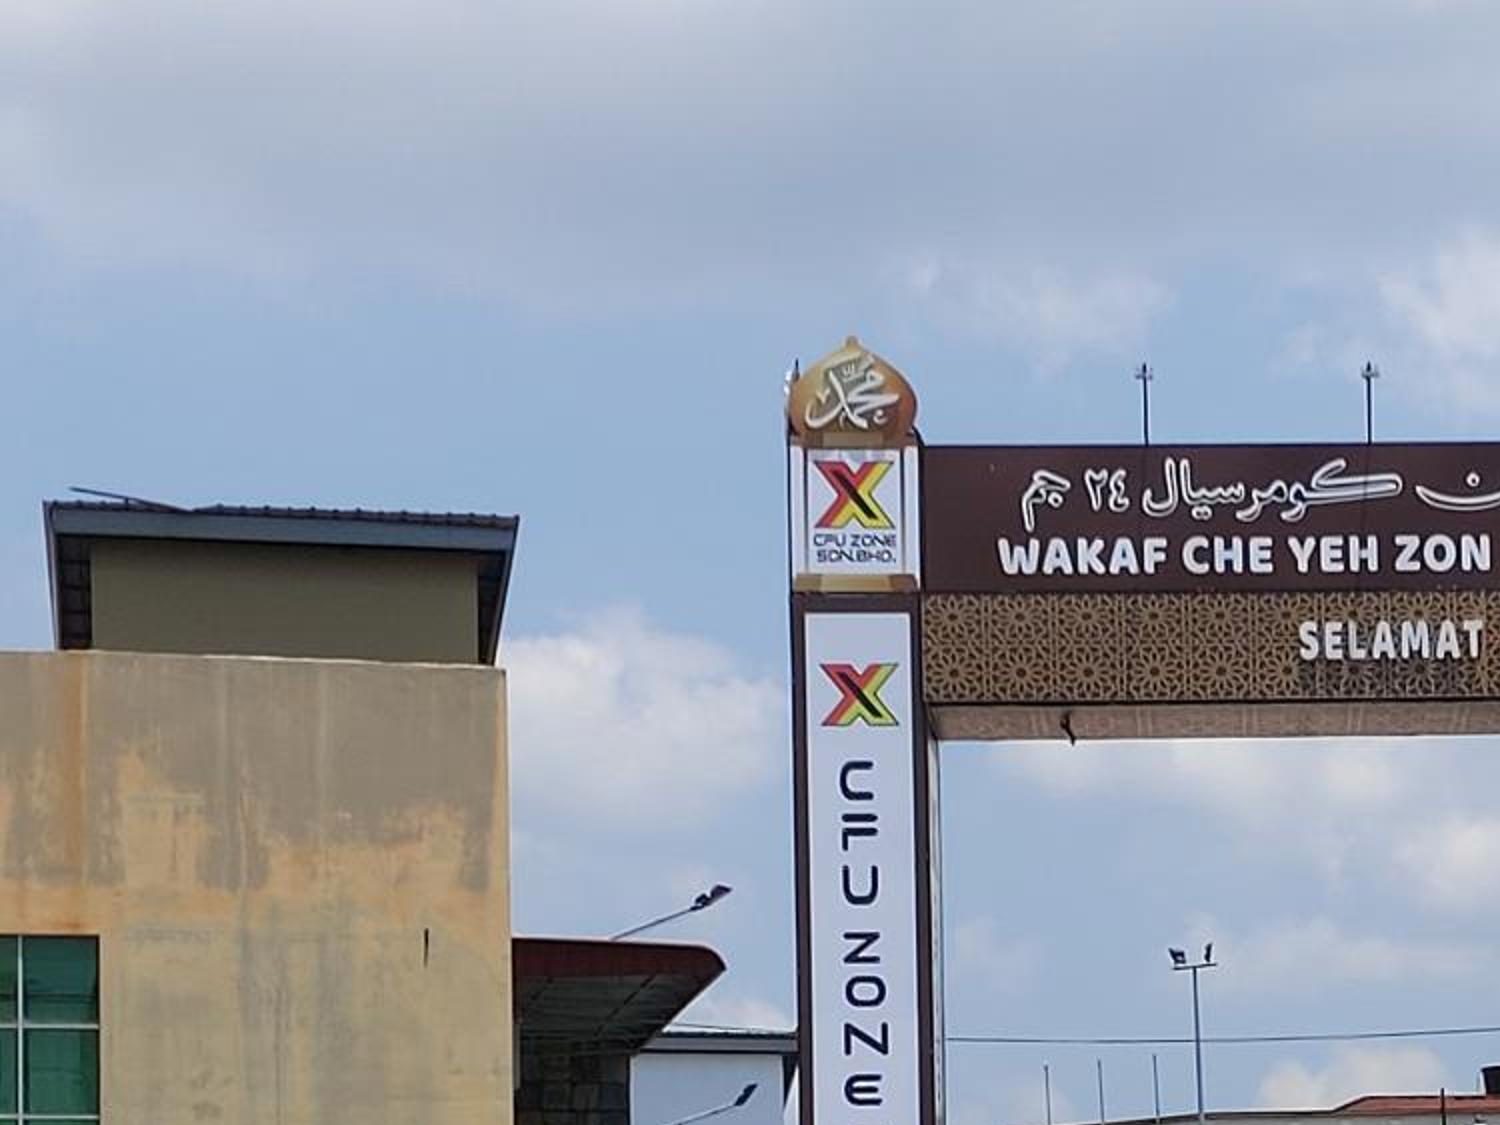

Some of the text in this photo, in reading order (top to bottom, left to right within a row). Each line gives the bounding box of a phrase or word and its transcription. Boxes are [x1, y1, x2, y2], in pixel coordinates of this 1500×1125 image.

[851, 532, 897, 548] ZONE
[997, 536, 1169, 575] WAKAF
[1181, 535, 1274, 573] CHE
[1288, 534, 1379, 572] YEH
[1394, 533, 1491, 571] ZON
[1299, 619, 1484, 660] SELAMAT
